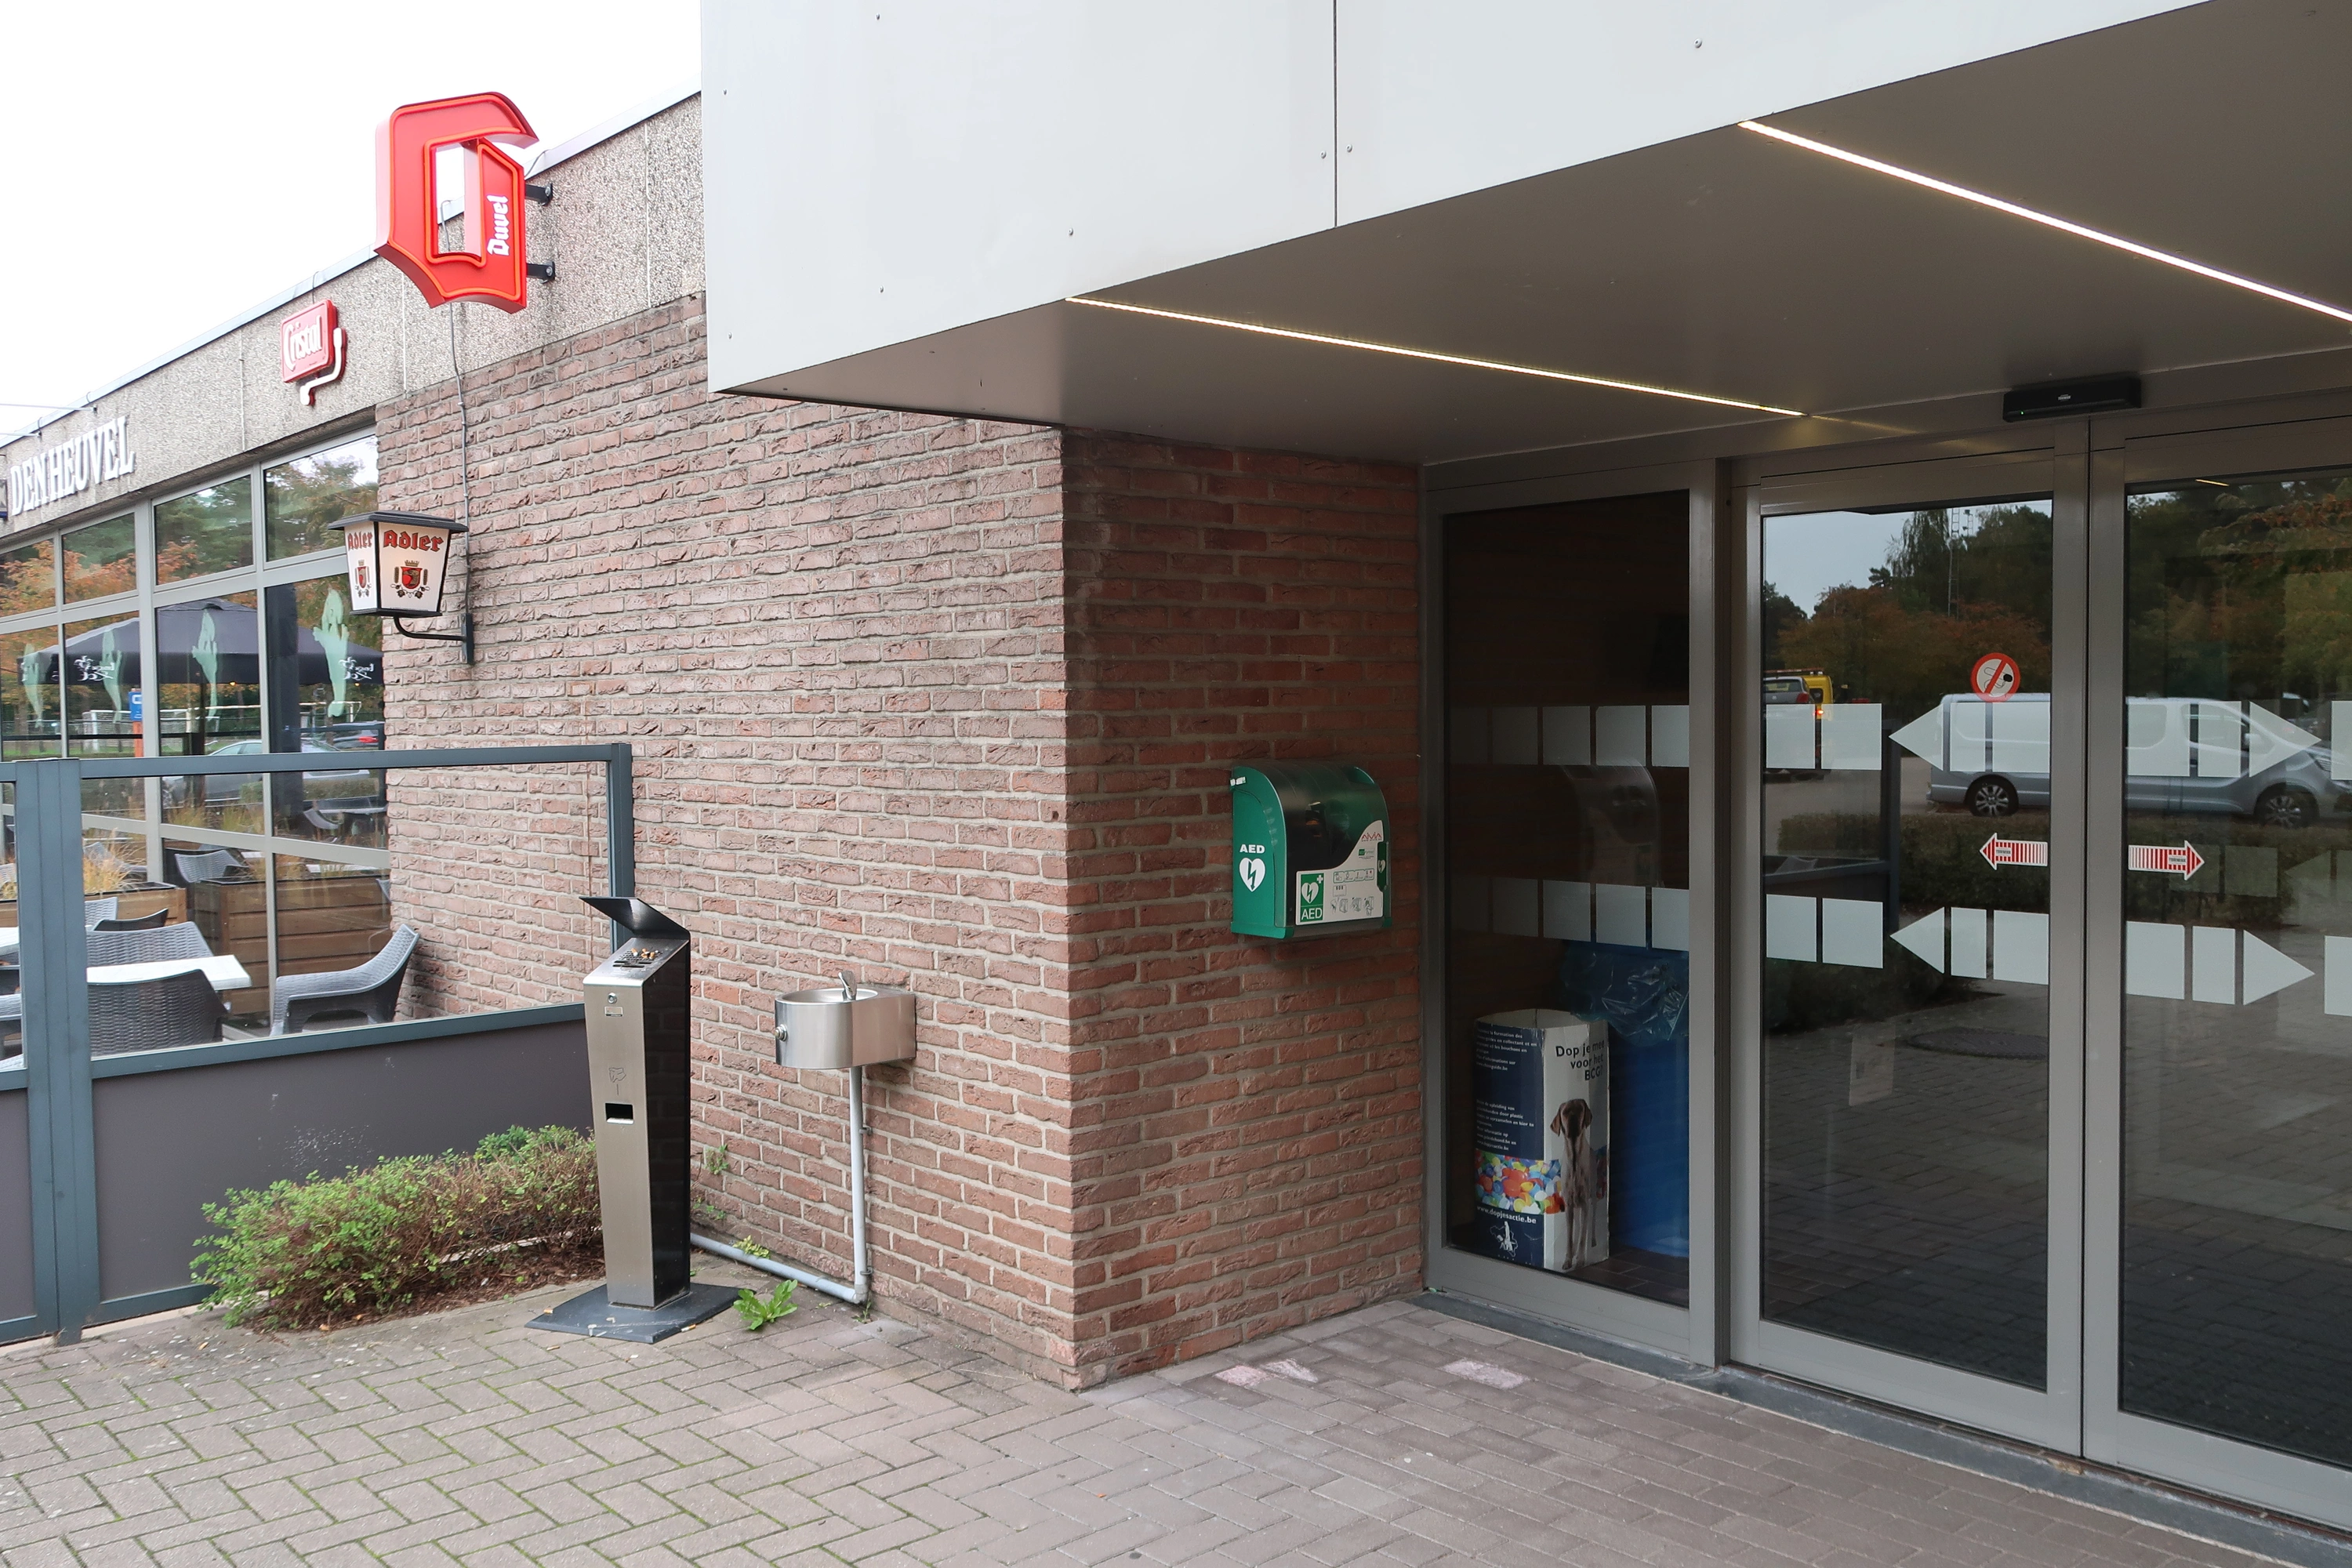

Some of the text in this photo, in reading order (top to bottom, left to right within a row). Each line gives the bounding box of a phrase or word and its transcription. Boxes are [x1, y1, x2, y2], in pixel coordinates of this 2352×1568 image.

[486, 194, 510, 256] Duvel
[284, 315, 322, 372] Cristal
[10, 416, 136, 516] DEN HEUVEL
[347, 532, 373, 551] Adler
[383, 529, 445, 552] Adler
[1240, 844, 1265, 854] AED
[1301, 907, 1323, 920] AED
[1555, 1040, 1605, 1058] Dop je mee
[1570, 1053, 1603, 1069] voor het
[1476, 1206, 1537, 1225] www.dopjesactie.be
